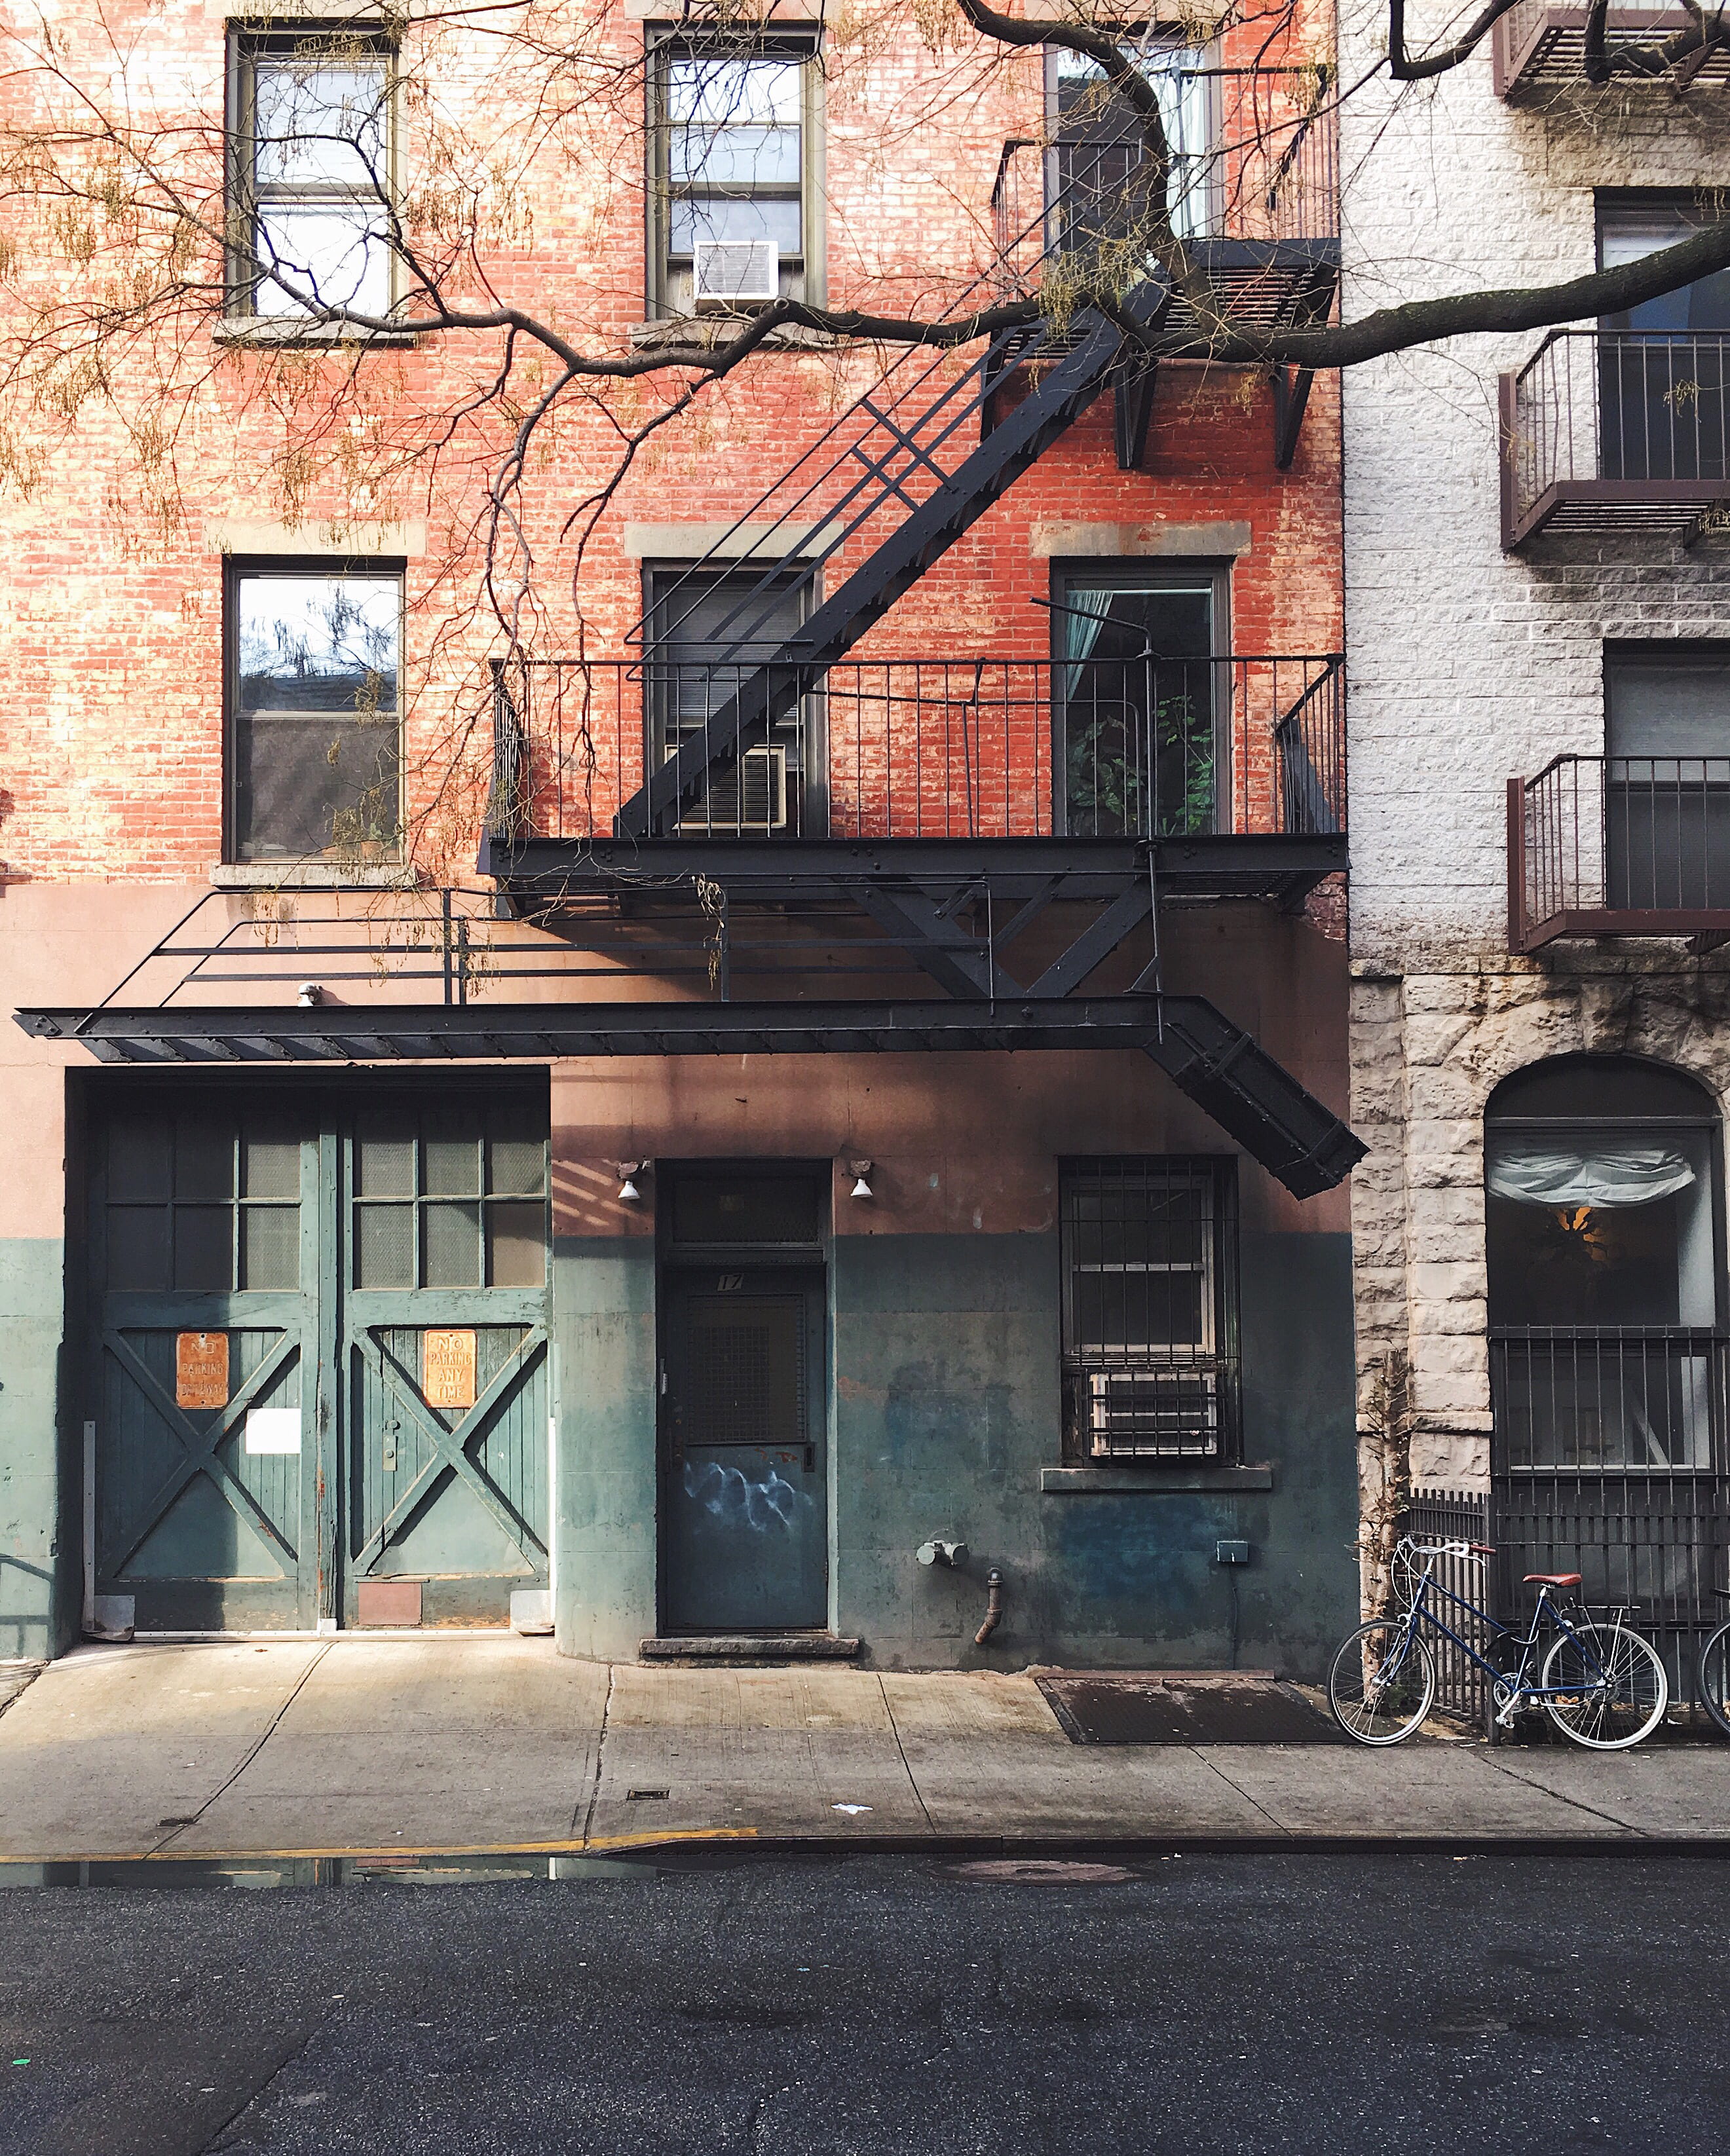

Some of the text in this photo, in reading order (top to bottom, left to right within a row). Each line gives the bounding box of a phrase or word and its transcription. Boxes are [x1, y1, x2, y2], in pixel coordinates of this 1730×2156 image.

[723, 1274, 742, 1290] 17
[191, 1341, 215, 1354] NO
[438, 1337, 463, 1351] NO
[430, 1352, 472, 1366] PARKING
[182, 1362, 224, 1376] PARKING
[438, 1368, 464, 1382] ANY
[437, 1385, 464, 1399] TIME
